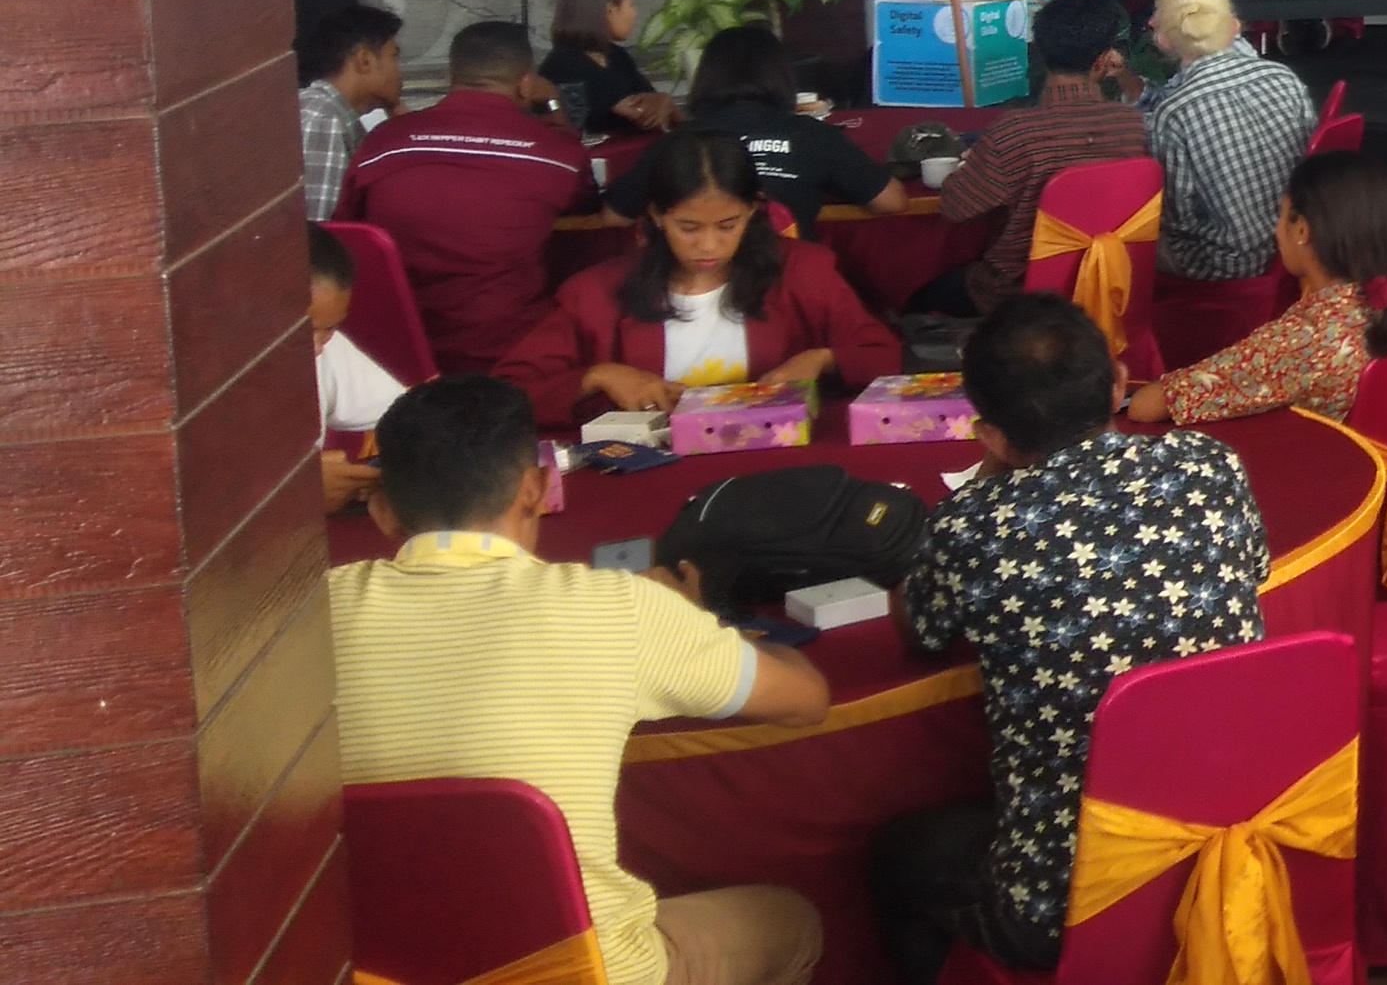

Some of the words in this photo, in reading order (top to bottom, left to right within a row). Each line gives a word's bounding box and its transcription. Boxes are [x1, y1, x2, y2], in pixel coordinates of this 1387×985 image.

[890, 9, 923, 23] Digital
[890, 24, 923, 39] Safety
[747, 139, 790, 153] INGGA
